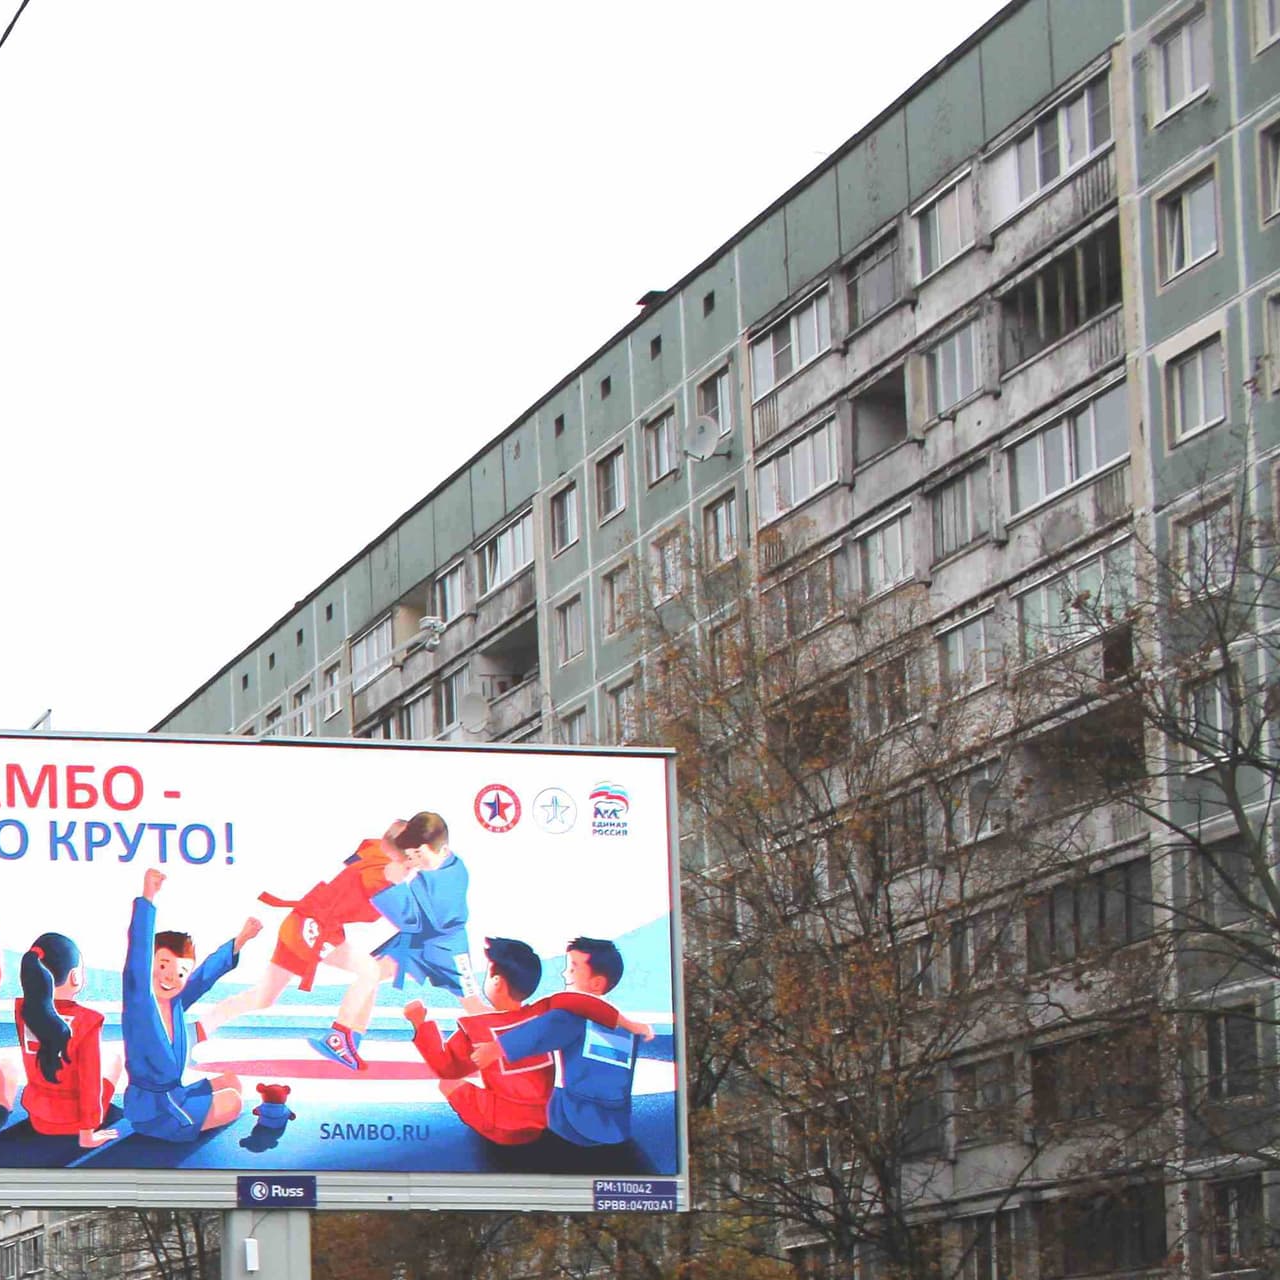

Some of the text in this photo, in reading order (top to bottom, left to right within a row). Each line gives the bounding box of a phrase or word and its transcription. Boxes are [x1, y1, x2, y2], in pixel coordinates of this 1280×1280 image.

[49, 820, 235, 865] КРУТО!
[319, 1123, 430, 1141] SAMBO.RU
[272, 1185, 304, 1197] Russ
